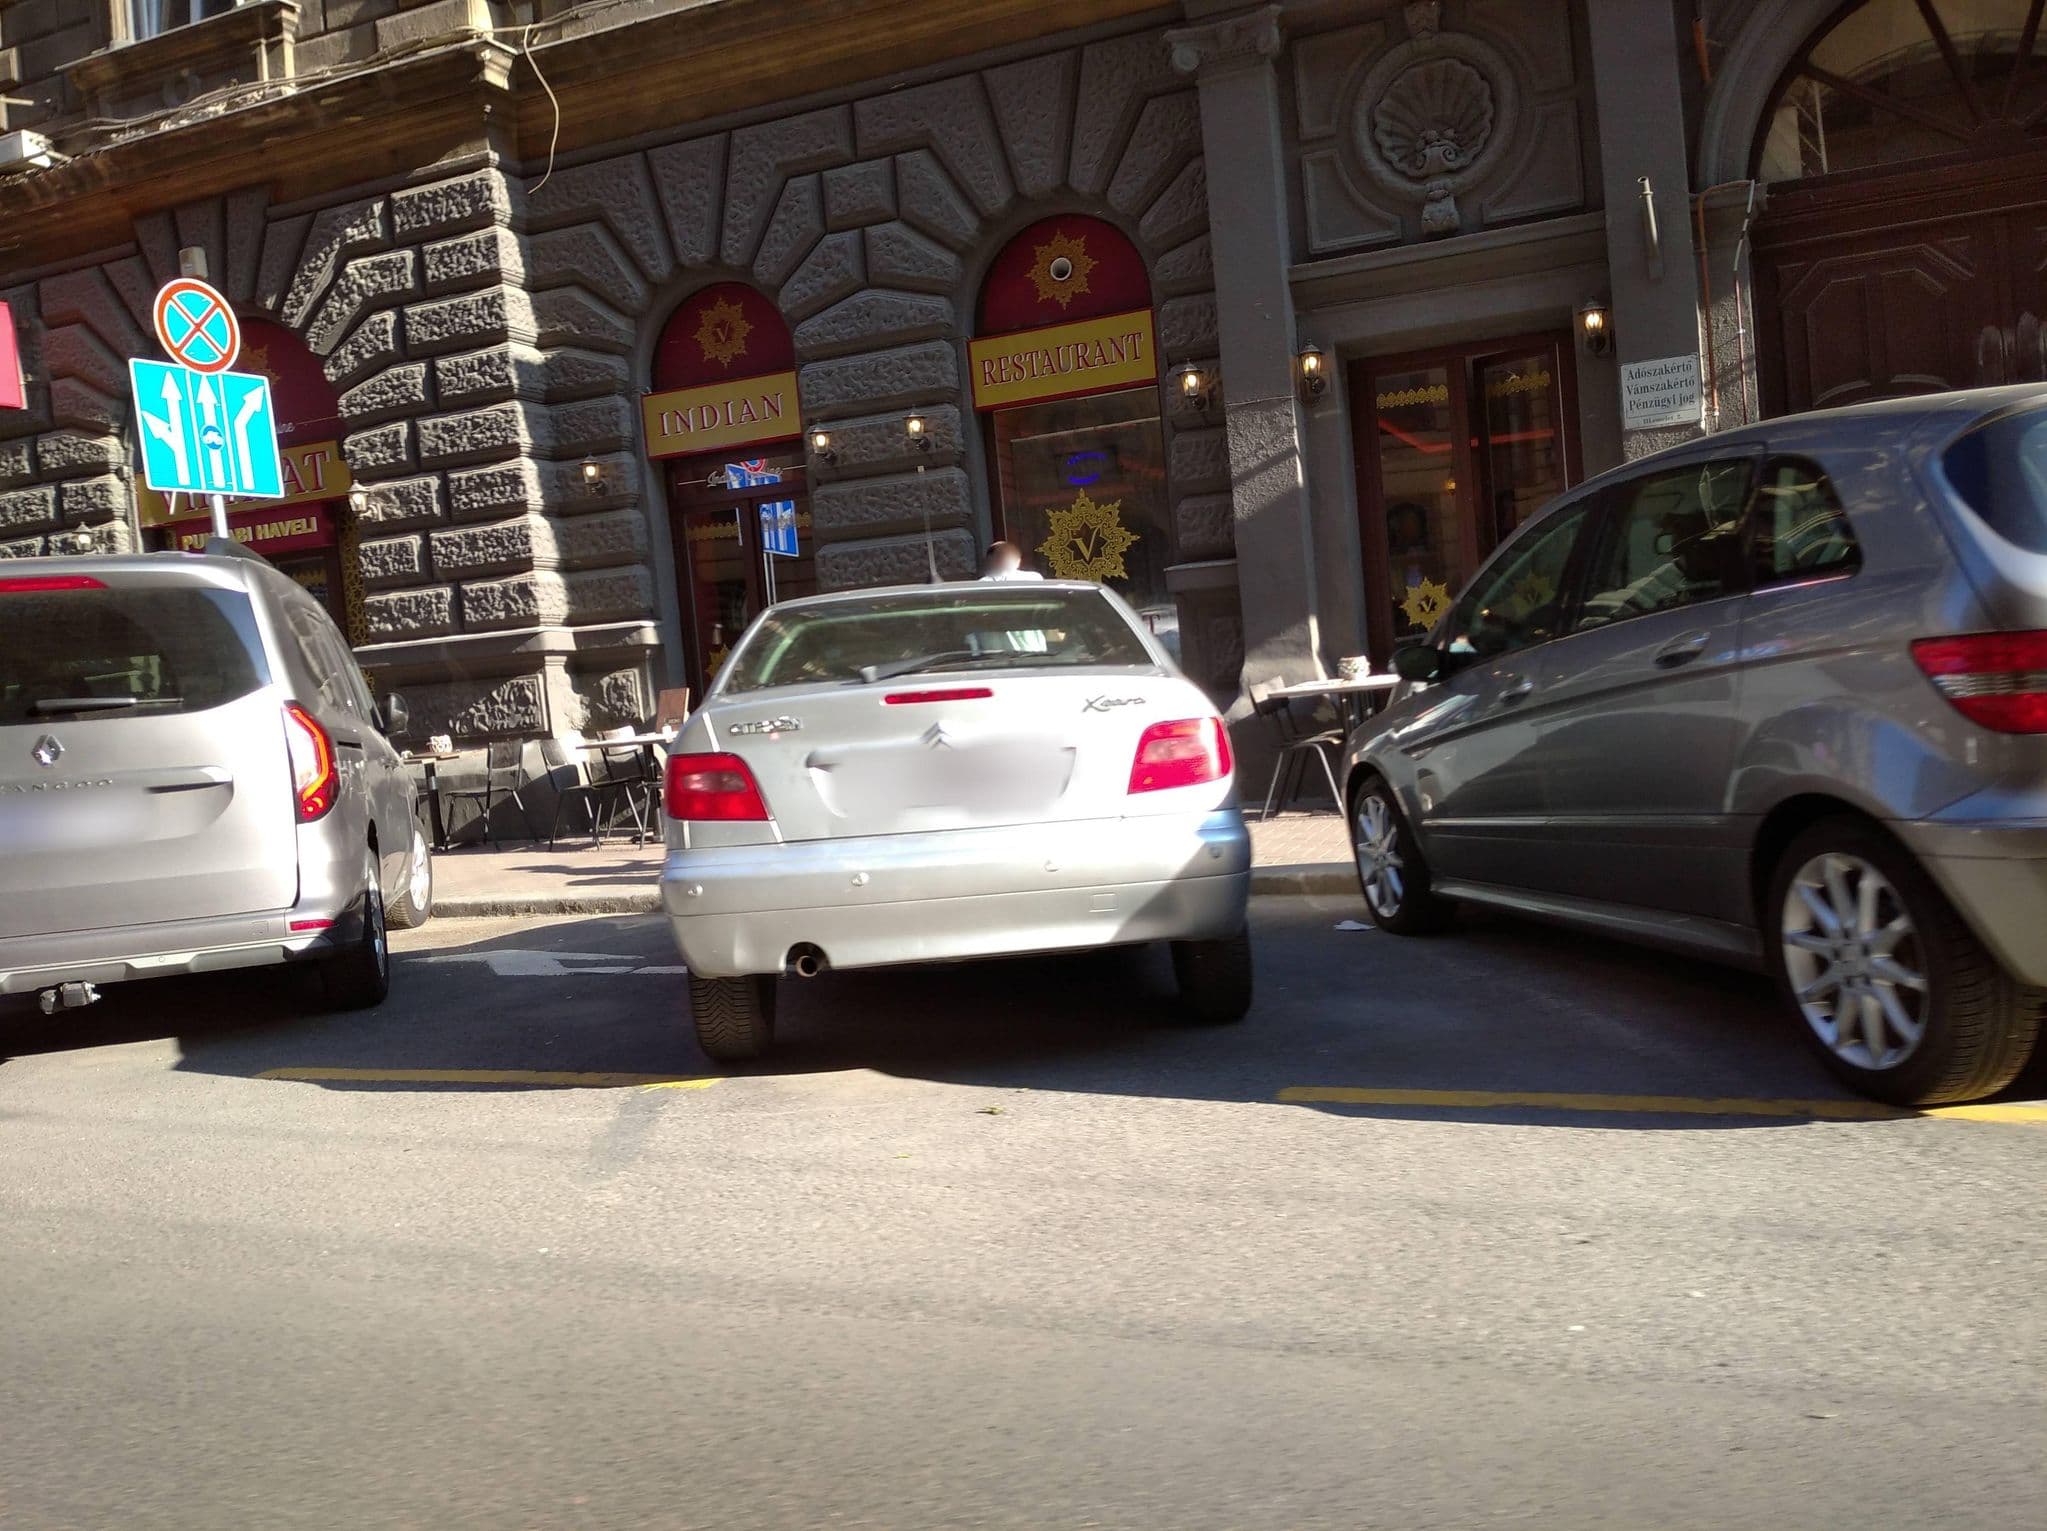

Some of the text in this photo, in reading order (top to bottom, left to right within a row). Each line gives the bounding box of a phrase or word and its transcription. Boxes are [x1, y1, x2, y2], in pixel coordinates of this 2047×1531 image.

[981, 331, 1144, 388] RESTAURANT
[659, 392, 783, 437] INDIAN
[1679, 393, 1695, 406] jog
[181, 516, 318, 551] PUBI HAVELI
